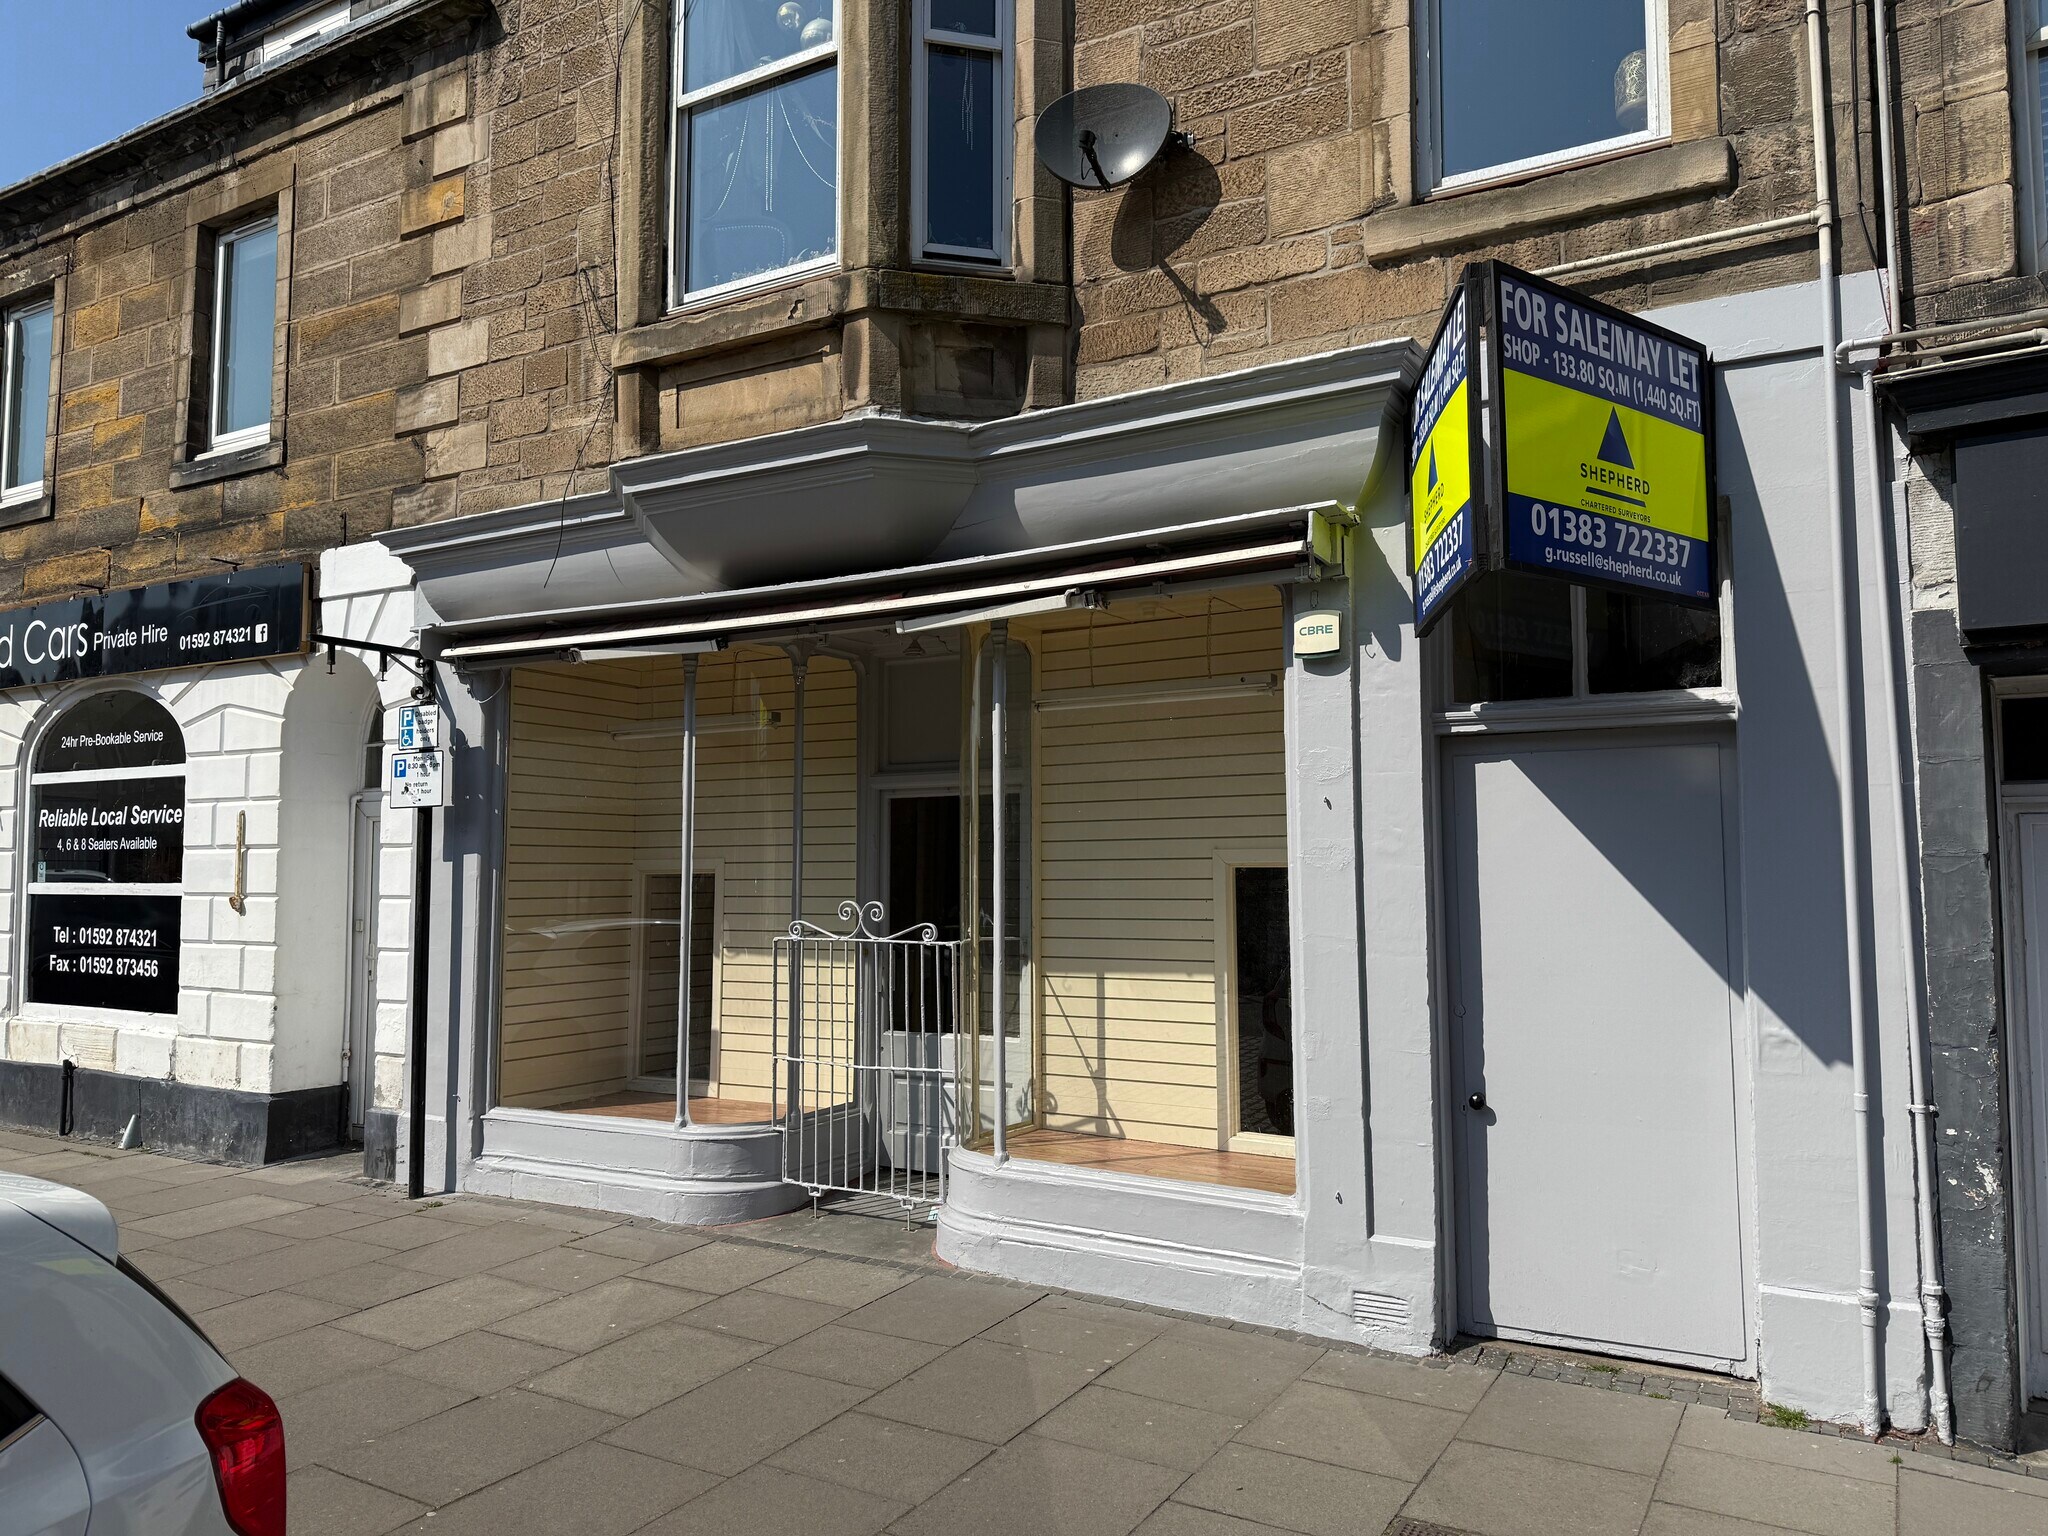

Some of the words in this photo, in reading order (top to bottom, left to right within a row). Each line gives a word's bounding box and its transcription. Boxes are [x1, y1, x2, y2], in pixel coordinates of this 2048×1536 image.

[1500, 280, 1549, 337] FOR
[1554, 303, 1661, 377] SALE/MAY
[1668, 346, 1699, 393] LET
[1503, 333, 1541, 366] SHOP
[1552, 351, 1595, 385] 133.80
[1598, 366, 1630, 397] SQ.M
[1633, 377, 1667, 411] (1,440
[1669, 392, 1701, 427] SQ.FT)
[1580, 463, 1650, 495] SHEPHERD
[1580, 499, 1617, 514] CHARTERED
[1618, 508, 1651, 523] SURVEYORS
[1434, 511, 1463, 573] 722337
[1531, 503, 1607, 549] 01383
[1614, 522, 1690, 568] 722337
[1545, 546, 1682, 586] g.russell@shepherd.co.uk
[24, 620, 88, 664] Cars
[93, 631, 137, 651] Private
[141, 625, 168, 645] Hire
[179, 633, 211, 650] 01592
[213, 626, 251, 648] 874321
[1299, 625, 1334, 636] CBRE
[61, 735, 78, 749] 24hr
[80, 732, 131, 747] Pre-Bookable
[133, 730, 163, 743] Service
[39, 808, 88, 828] Reliable
[91, 806, 126, 826] Local
[130, 804, 182, 825] Service
[57, 839, 65, 852] 4,
[66, 838, 72, 851] 6
[73, 838, 80, 851] &
[81, 838, 86, 850] 8
[88, 837, 118, 851] Seaters
[120, 836, 157, 850] Available
[53, 926, 69, 944] Tel
[79, 927, 113, 946] 01592
[116, 928, 158, 947] 874321
[49, 954, 70, 973] Fax
[79, 955, 113, 974] 01592
[116, 958, 159, 978] 873456
